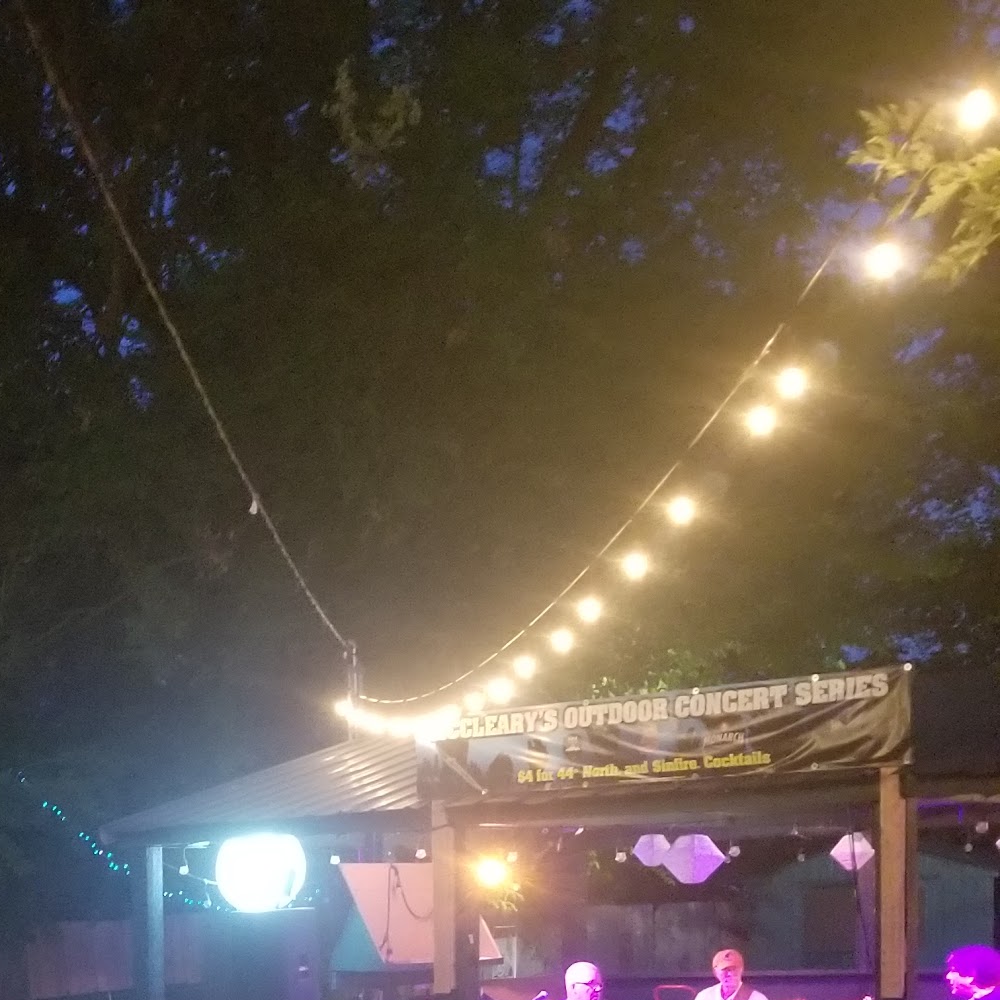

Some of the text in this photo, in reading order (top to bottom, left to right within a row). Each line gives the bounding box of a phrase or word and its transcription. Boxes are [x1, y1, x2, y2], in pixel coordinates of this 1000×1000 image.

[433, 672, 890, 741] CCLEARY'S OUTDOOR CONCERT SERIES
[624, 761, 649, 775] and
[703, 750, 772, 769] Cocktails
